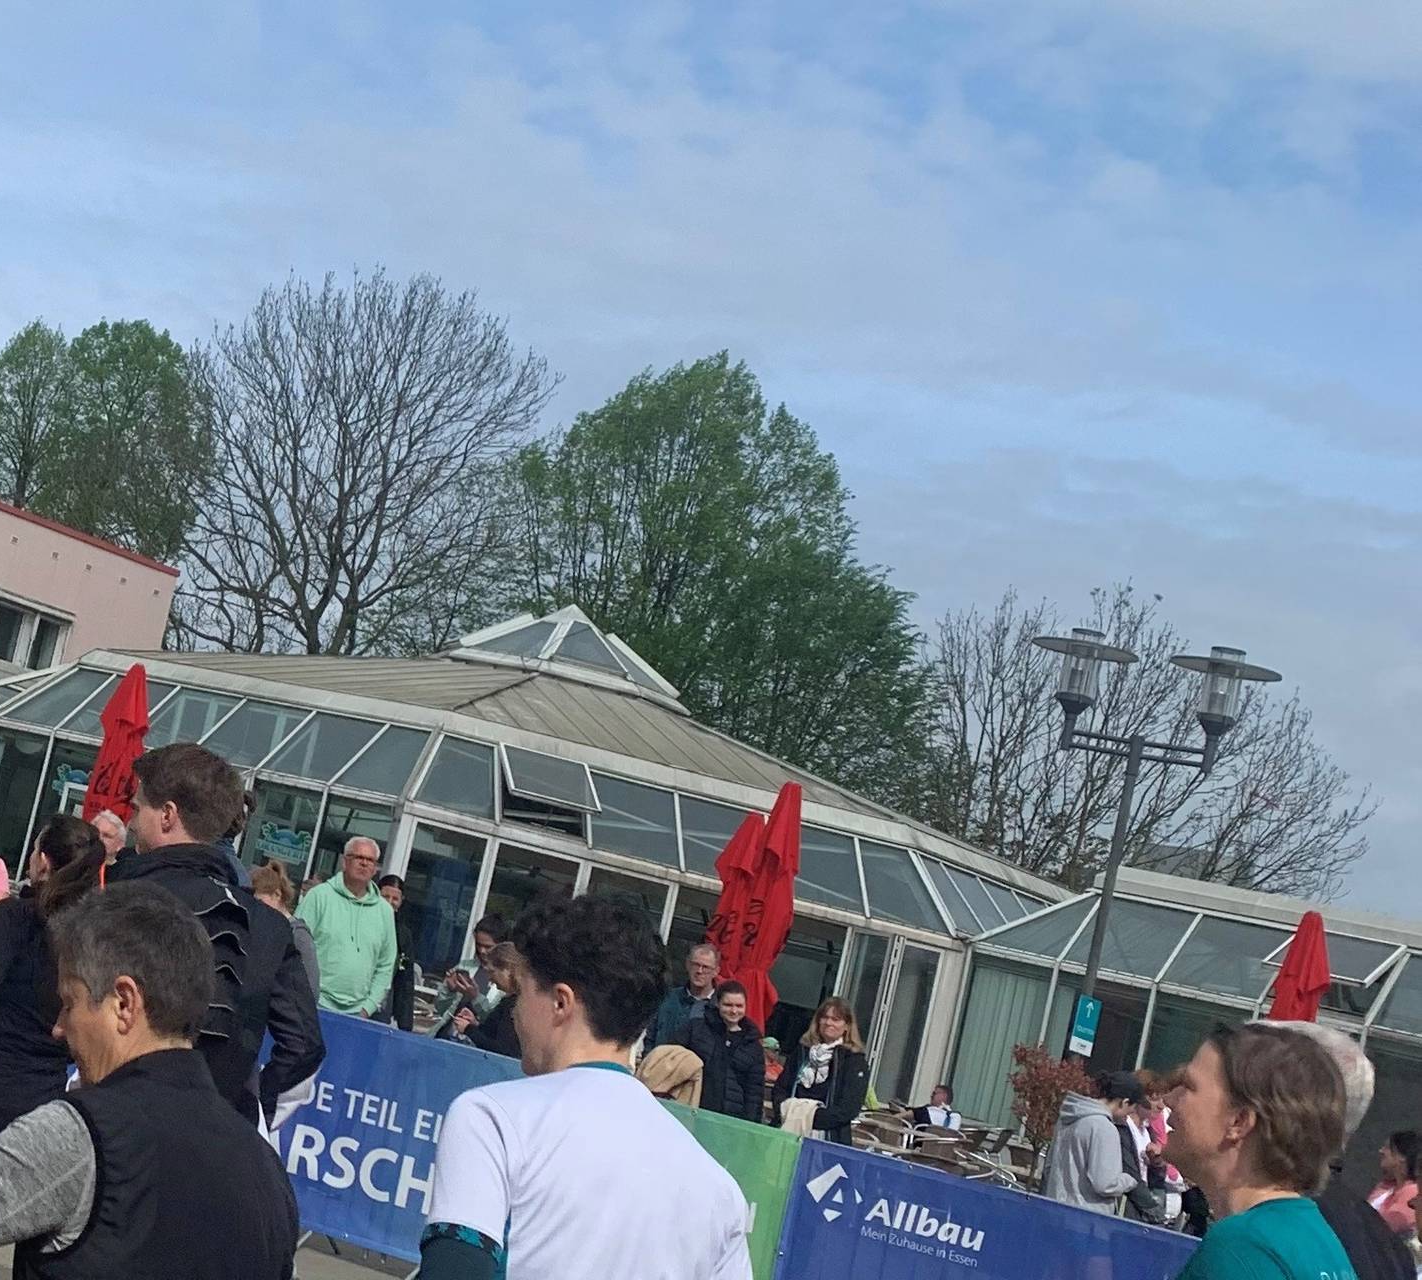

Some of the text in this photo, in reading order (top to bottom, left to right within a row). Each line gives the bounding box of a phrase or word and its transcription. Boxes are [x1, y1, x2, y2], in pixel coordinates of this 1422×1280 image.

[343, 1087, 403, 1134] TEIL
[270, 1124, 435, 1216] RSCH
[860, 1225, 978, 1268] Mein Zuhause in Essen
[864, 1198, 986, 1252] Allbau
